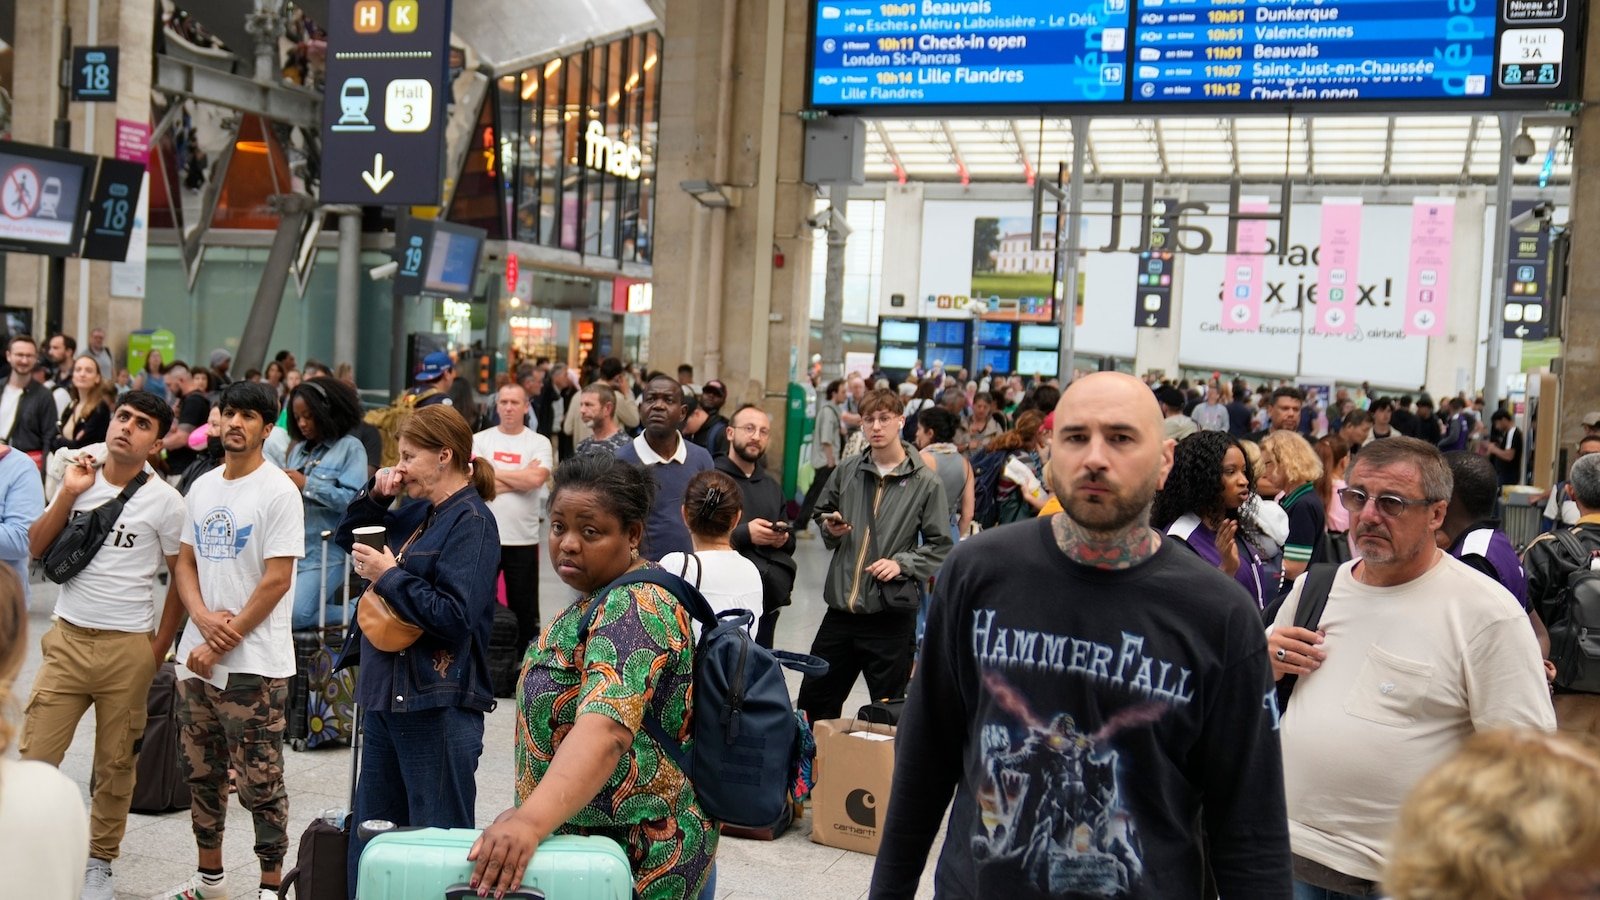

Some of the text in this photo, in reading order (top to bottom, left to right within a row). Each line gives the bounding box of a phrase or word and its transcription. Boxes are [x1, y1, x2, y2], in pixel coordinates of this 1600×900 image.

[880, 4, 916, 16] 10h01
[921, 0, 991, 16] Beauvais
[1510, 2, 1543, 11] Niveau
[360, 6, 376, 27] H
[396, 5, 411, 26] K
[866, 19, 909, 32] Esches
[919, 17, 953, 30] Méru
[963, 15, 1036, 29] Laboissière
[1050, 14, 1065, 27] Le
[1207, 10, 1245, 23] 10h51
[1256, 7, 1339, 22] Dunkerque
[1206, 28, 1244, 41] 10h51
[1255, 25, 1354, 40] Valenciennes
[1519, 36, 1547, 44] Hall
[877, 37, 914, 51] 10h11
[919, 34, 985, 51] Check-in
[988, 35, 1027, 51] open
[842, 51, 961, 67] London St-Pancras
[1205, 47, 1243, 60] 11h01
[1253, 44, 1319, 59] Beauvais
[1521, 48, 1542, 58] 3A
[81, 64, 110, 90] 18
[876, 71, 913, 84] 10h14
[918, 69, 951, 85] Lille
[955, 66, 1024, 84] Flandres
[1204, 65, 1242, 78] 11h07
[1252, 60, 1434, 77] Saint-Just-en-Chaussée
[394, 85, 423, 99] Hall
[841, 86, 924, 99] Lille Flandres
[1203, 83, 1241, 97] 11h12
[402, 105, 413, 124] 3
[585, 119, 641, 180] fnac
[102, 198, 129, 230] 18
[1519, 242, 1537, 253] BUS
[406, 247, 422, 271] 19
[54, 549, 85, 577] FREE LIFE
[833, 823, 876, 837] carhartt
